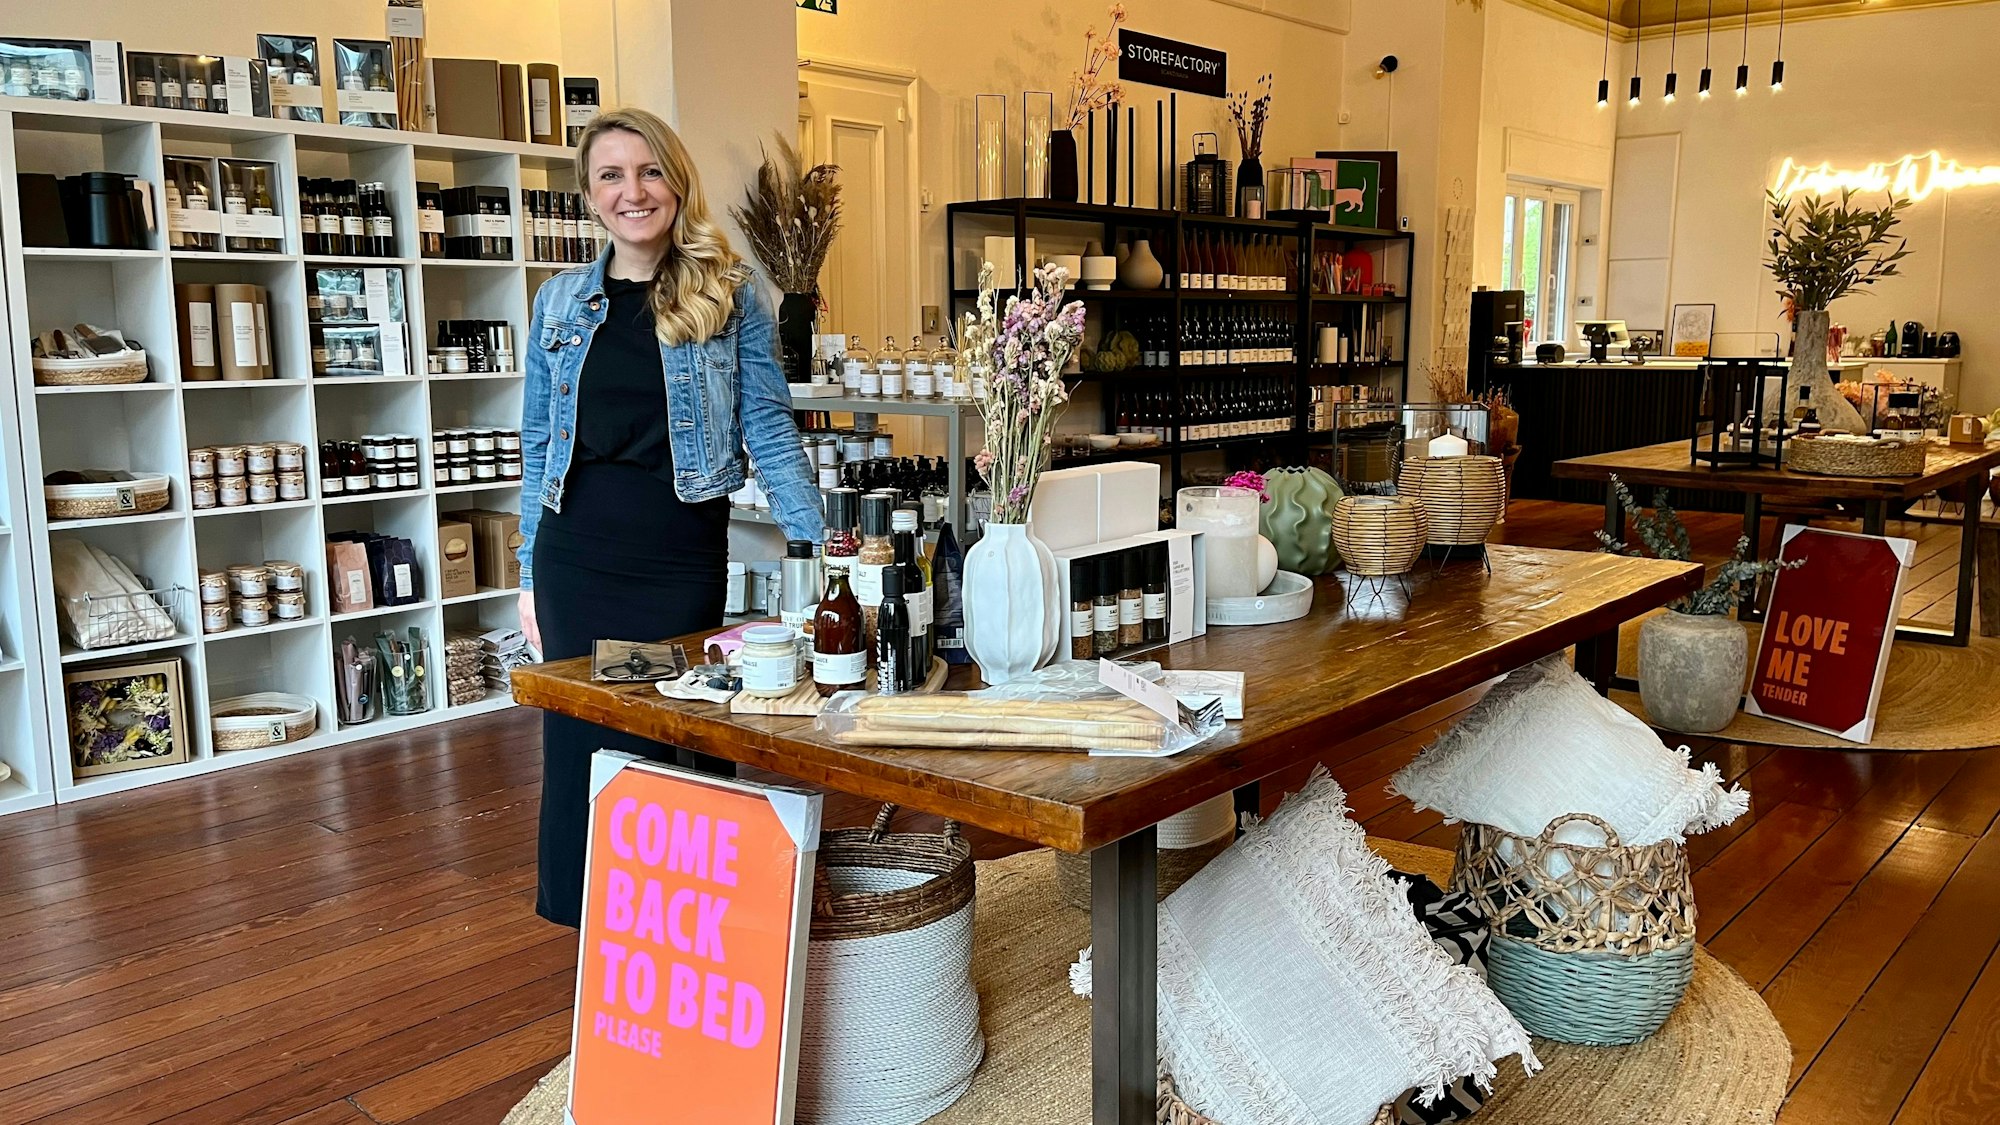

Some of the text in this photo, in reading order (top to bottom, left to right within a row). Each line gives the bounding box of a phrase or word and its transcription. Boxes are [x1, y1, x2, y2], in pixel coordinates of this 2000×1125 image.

[1128, 43, 1218, 76] STOREFACTORY
[121, 493, 131, 505] &
[1775, 610, 1850, 656] LOVE
[1766, 648, 1812, 687] ME
[1762, 682, 1808, 707] TENDER
[272, 725, 281, 736] &
[609, 796, 741, 887] COME
[604, 868, 731, 963] BACK
[599, 939, 767, 1050] TO BED
[594, 1010, 663, 1059] PLEASE
